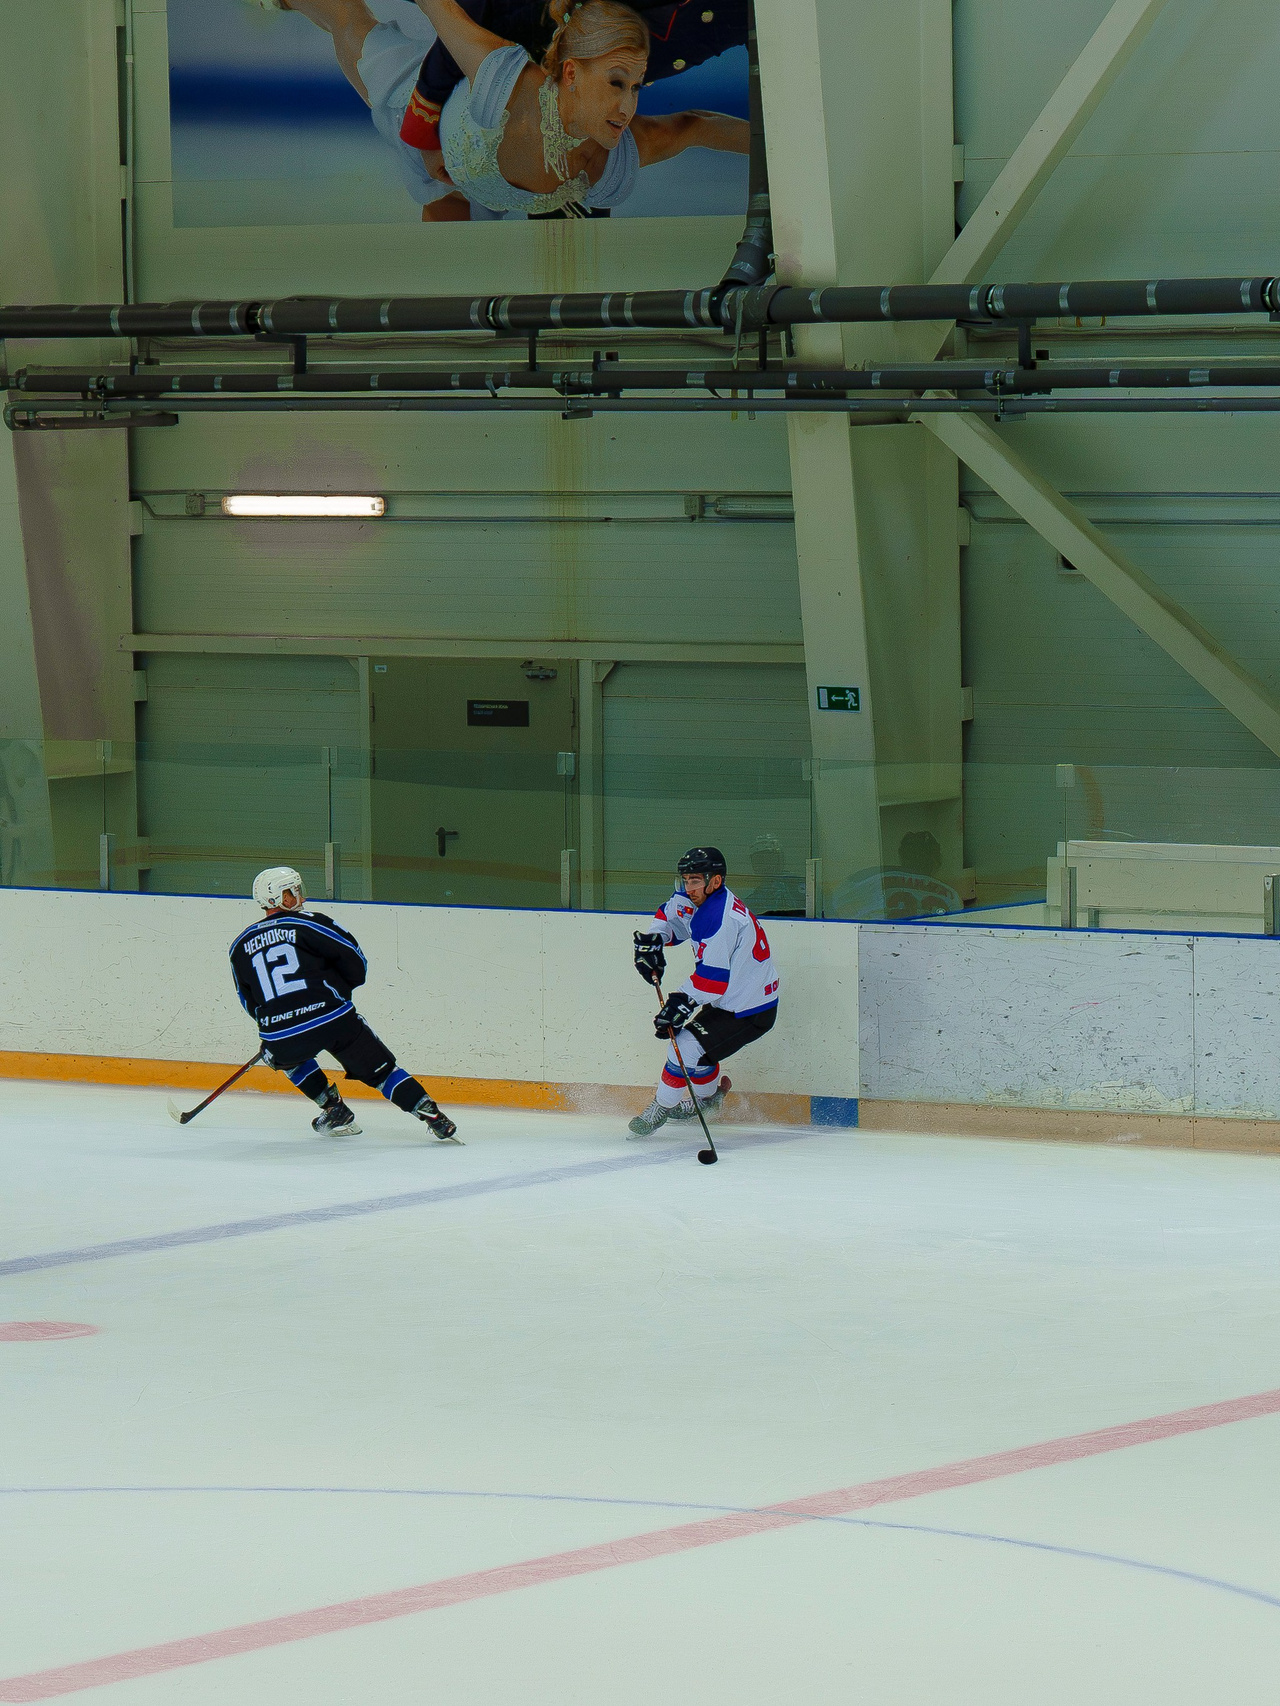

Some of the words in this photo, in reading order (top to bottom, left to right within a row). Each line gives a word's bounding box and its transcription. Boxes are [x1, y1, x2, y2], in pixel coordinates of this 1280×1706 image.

[251, 943, 308, 1002] 12
[270, 1012, 293, 1023] ONE
[295, 1001, 326, 1017] TIMER
